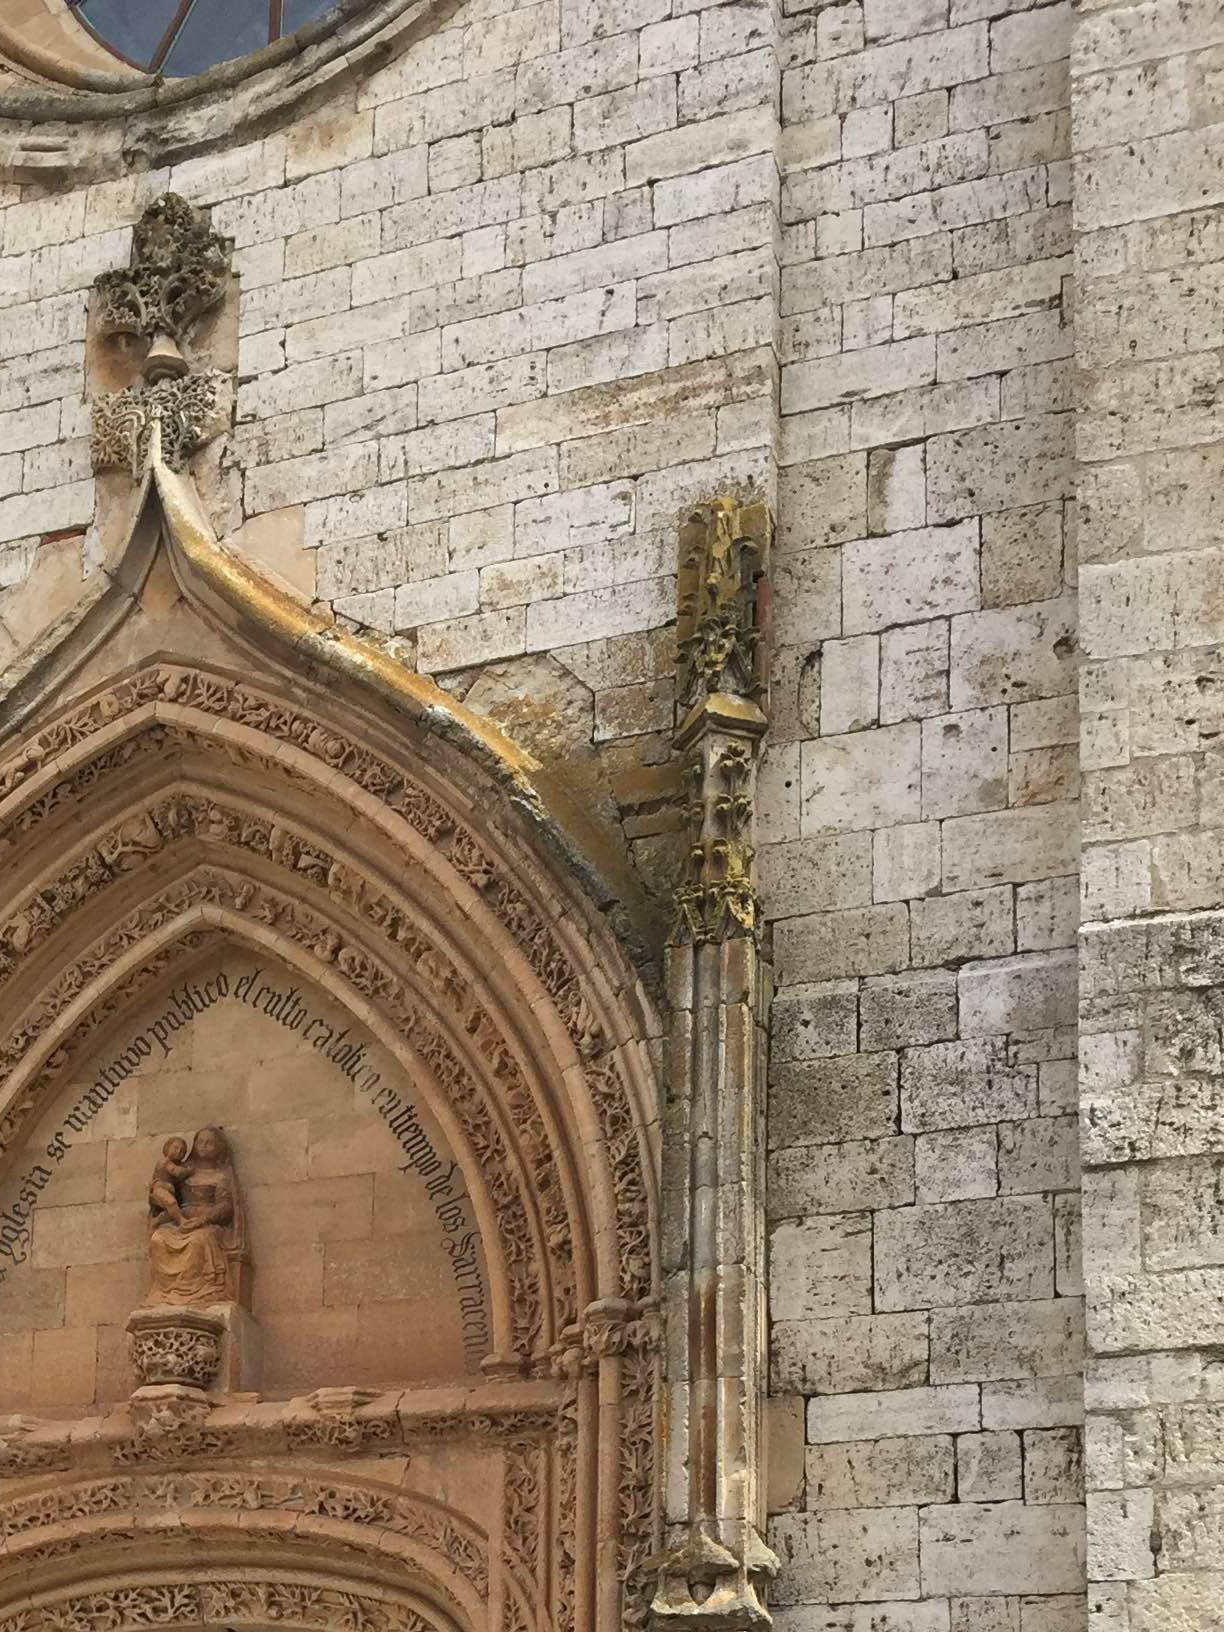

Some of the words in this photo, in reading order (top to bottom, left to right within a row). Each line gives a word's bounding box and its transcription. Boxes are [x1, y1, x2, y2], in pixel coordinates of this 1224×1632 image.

[234, 967, 264, 1003] el
[147, 972, 230, 1059] publico
[252, 986, 308, 1030] culto
[302, 1018, 381, 1092] catolico
[64, 1035, 152, 1132] mantuvo
[371, 1087, 402, 1119] en
[46, 1131, 72, 1166] se
[388, 1104, 442, 1176] tiempo
[424, 1160, 458, 1201] de
[435, 1192, 470, 1233] los
